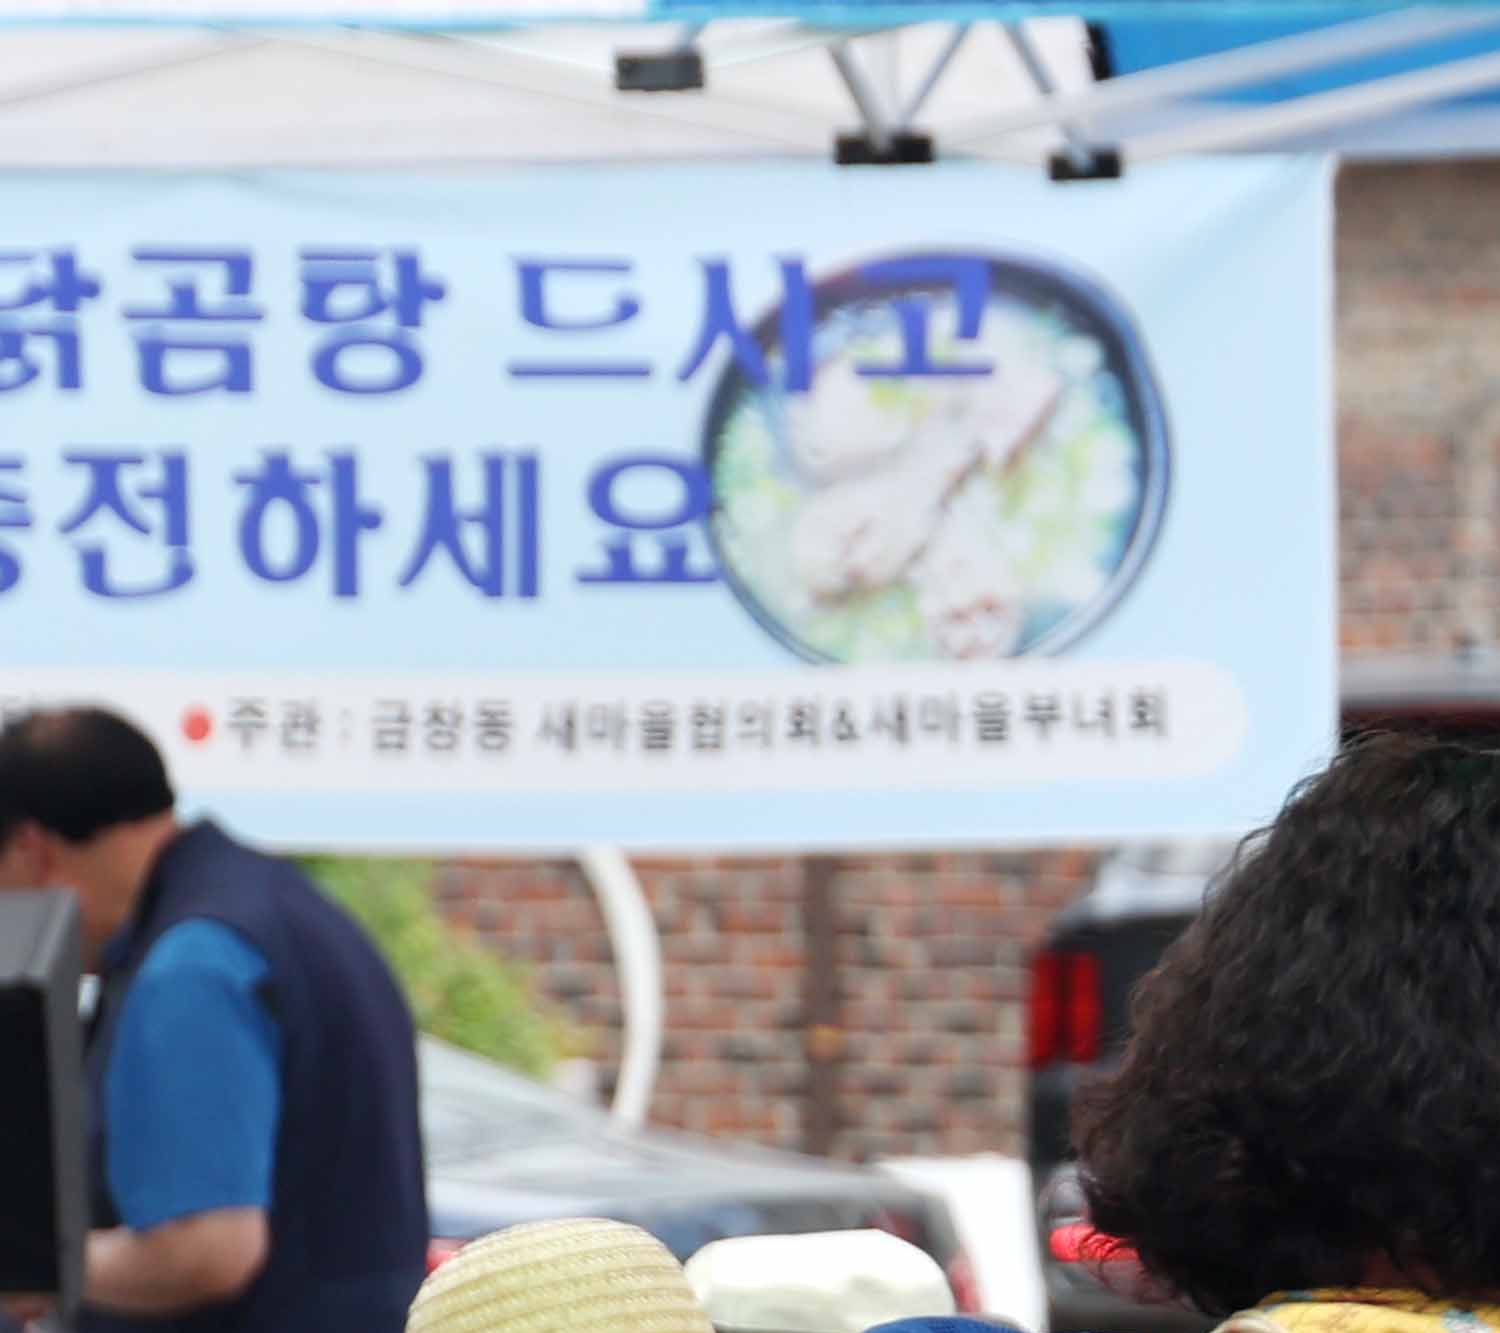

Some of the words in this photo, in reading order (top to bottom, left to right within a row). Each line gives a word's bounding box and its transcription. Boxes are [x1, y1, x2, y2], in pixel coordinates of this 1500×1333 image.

[0, 246, 448, 396] 닭곰탕
[506, 252, 995, 394] 드시고
[0, 448, 722, 600] 전하세요
[227, 695, 322, 750] 주관
